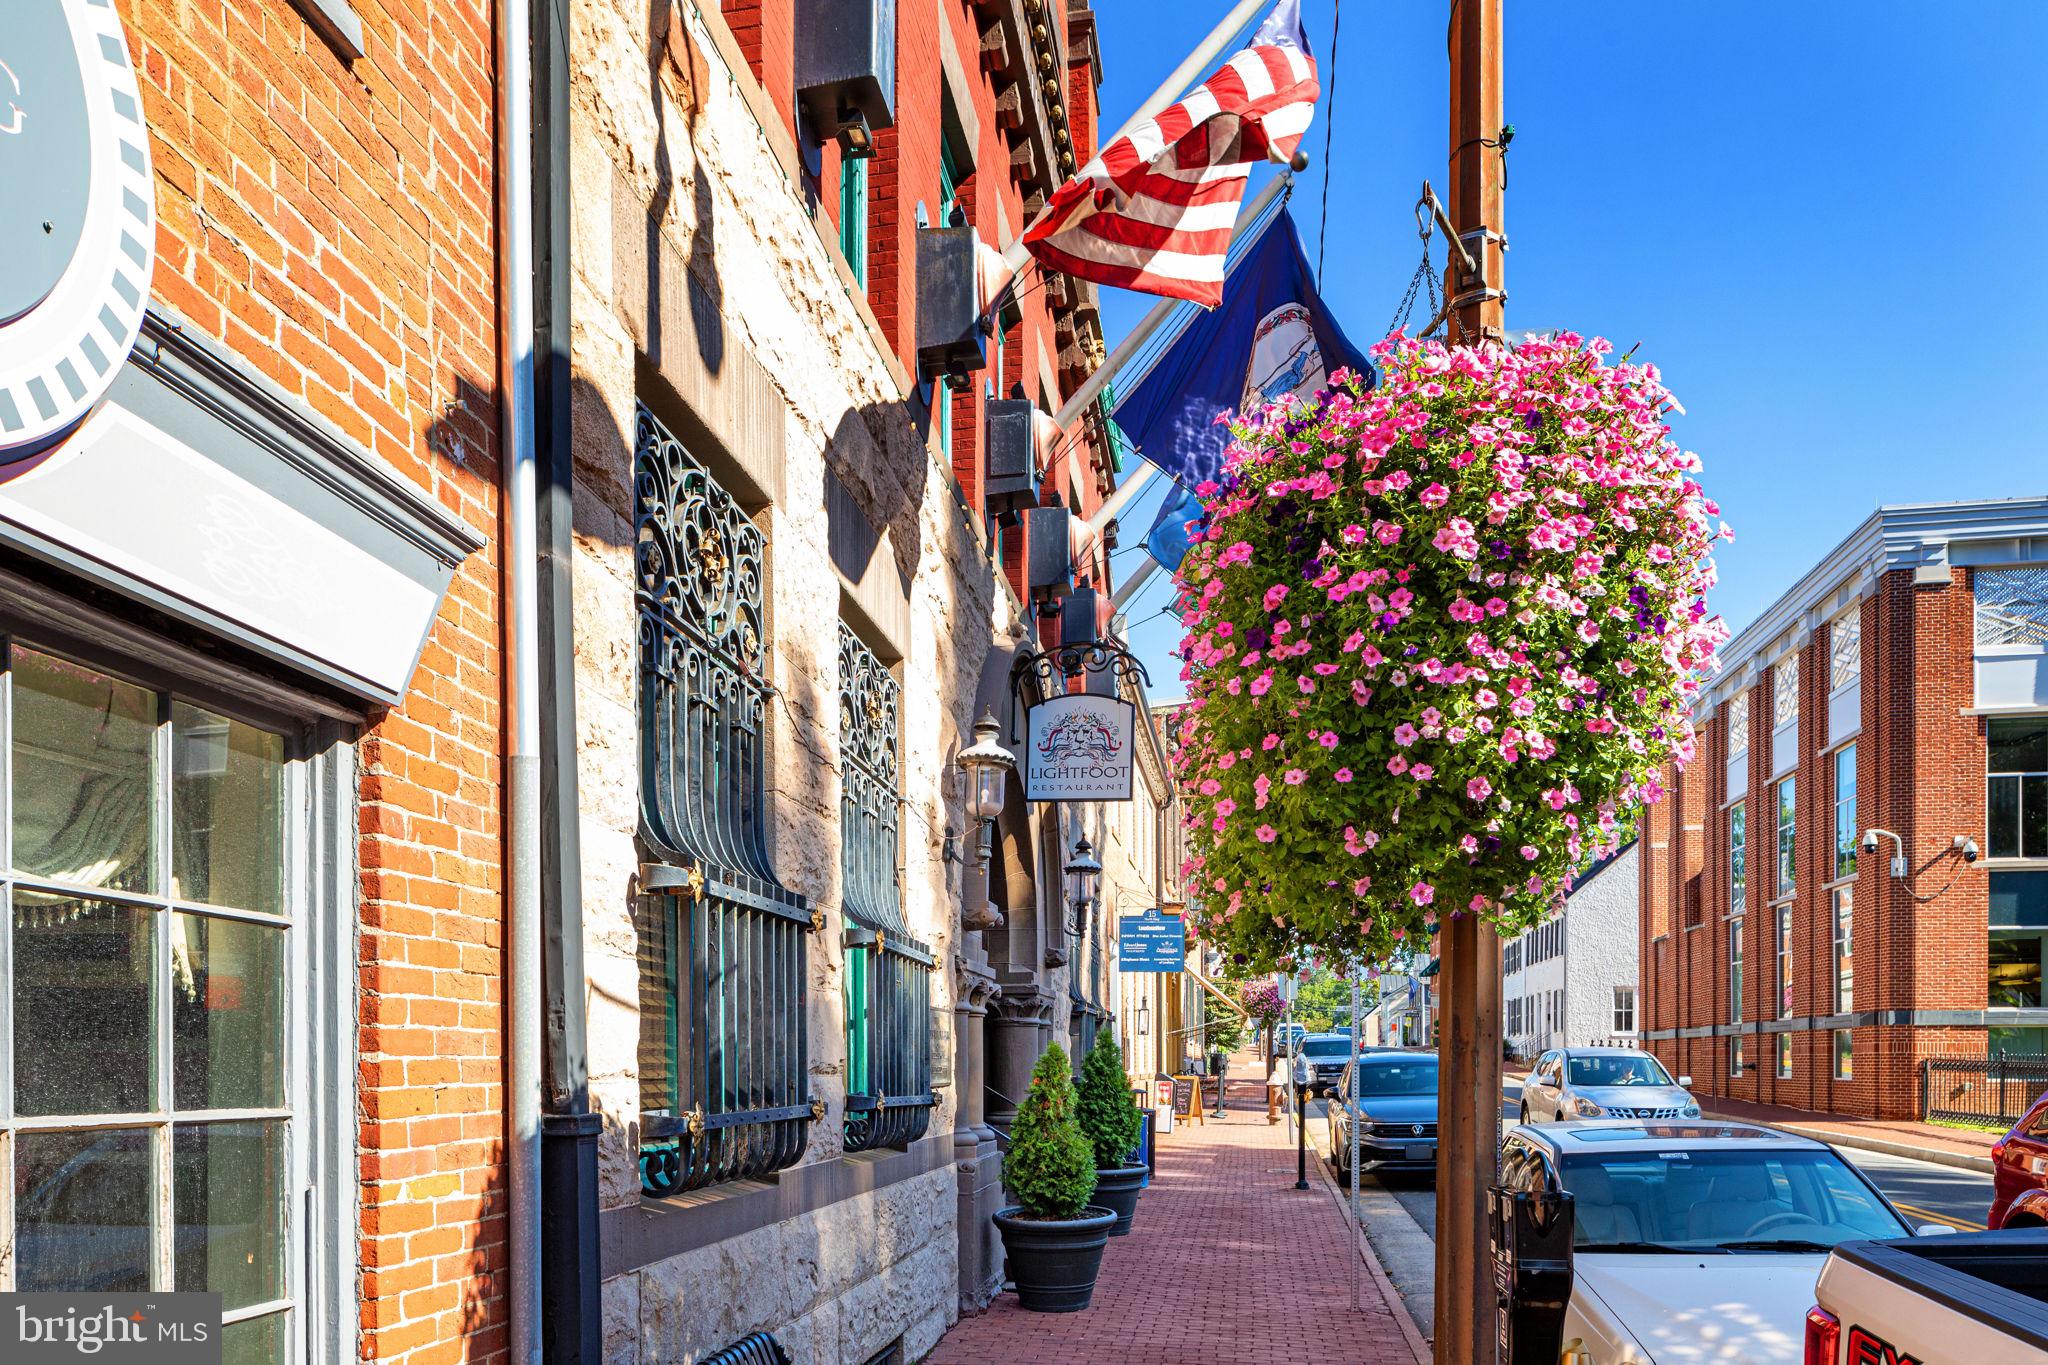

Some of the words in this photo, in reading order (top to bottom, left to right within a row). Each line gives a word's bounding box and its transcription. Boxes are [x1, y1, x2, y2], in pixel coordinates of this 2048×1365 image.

[1031, 766, 1129, 780] LIGHTFOOT
[1032, 783, 1125, 792] RESTAURANT
[1148, 910, 1157, 918] 15
